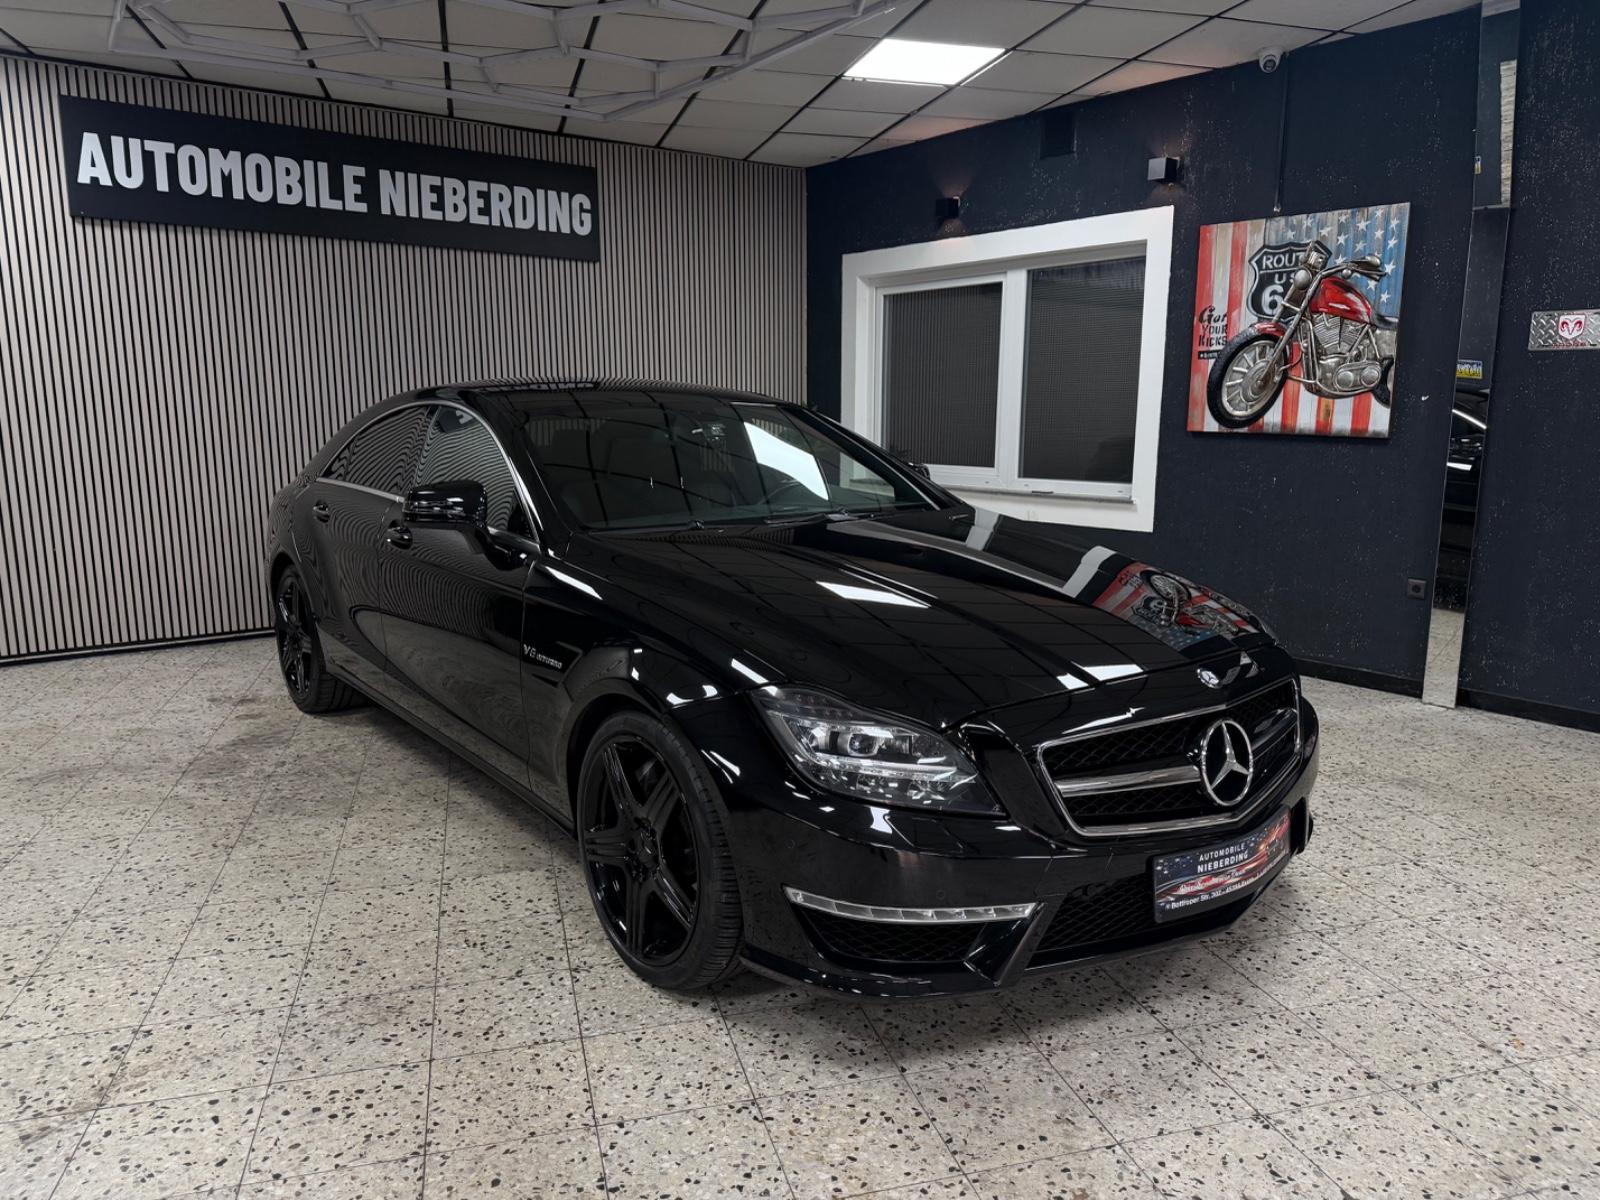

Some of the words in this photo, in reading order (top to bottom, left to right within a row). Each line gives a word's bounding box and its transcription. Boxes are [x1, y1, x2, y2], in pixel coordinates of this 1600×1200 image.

[76, 131, 368, 213] AUTOMOBILE
[379, 169, 593, 236] NIEBERDING
[1262, 252, 1307, 269] ROUT
[1261, 284, 1285, 316] 6
[1202, 324, 1228, 336] YOUR
[1198, 334, 1228, 347] KICKS
[1199, 843, 1246, 862] AUTOMOBILE
[1197, 851, 1249, 874] NIEBERDING
